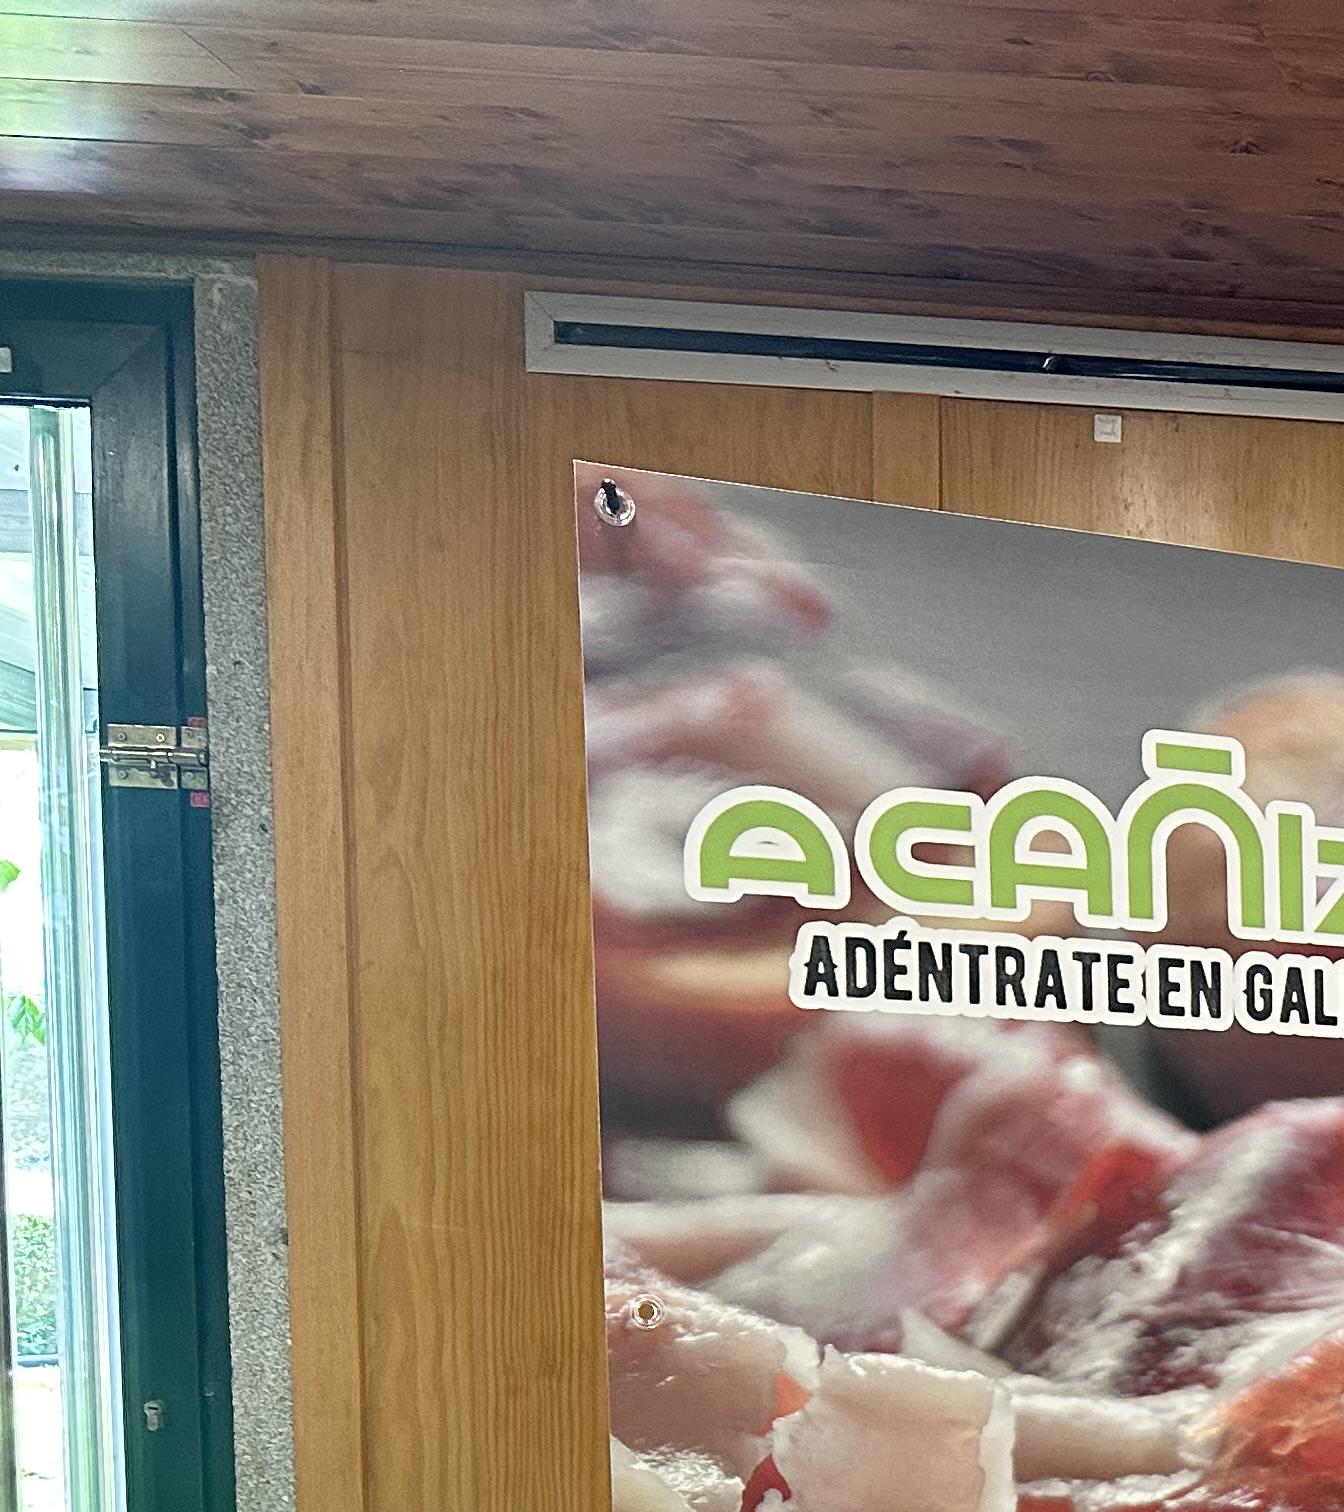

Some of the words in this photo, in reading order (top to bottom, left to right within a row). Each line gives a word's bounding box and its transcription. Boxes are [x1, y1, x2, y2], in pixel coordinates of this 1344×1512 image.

[697, 796, 839, 899] A
[803, 930, 1140, 1014] ADÉNTRATE
[1159, 958, 1220, 1018] EN
